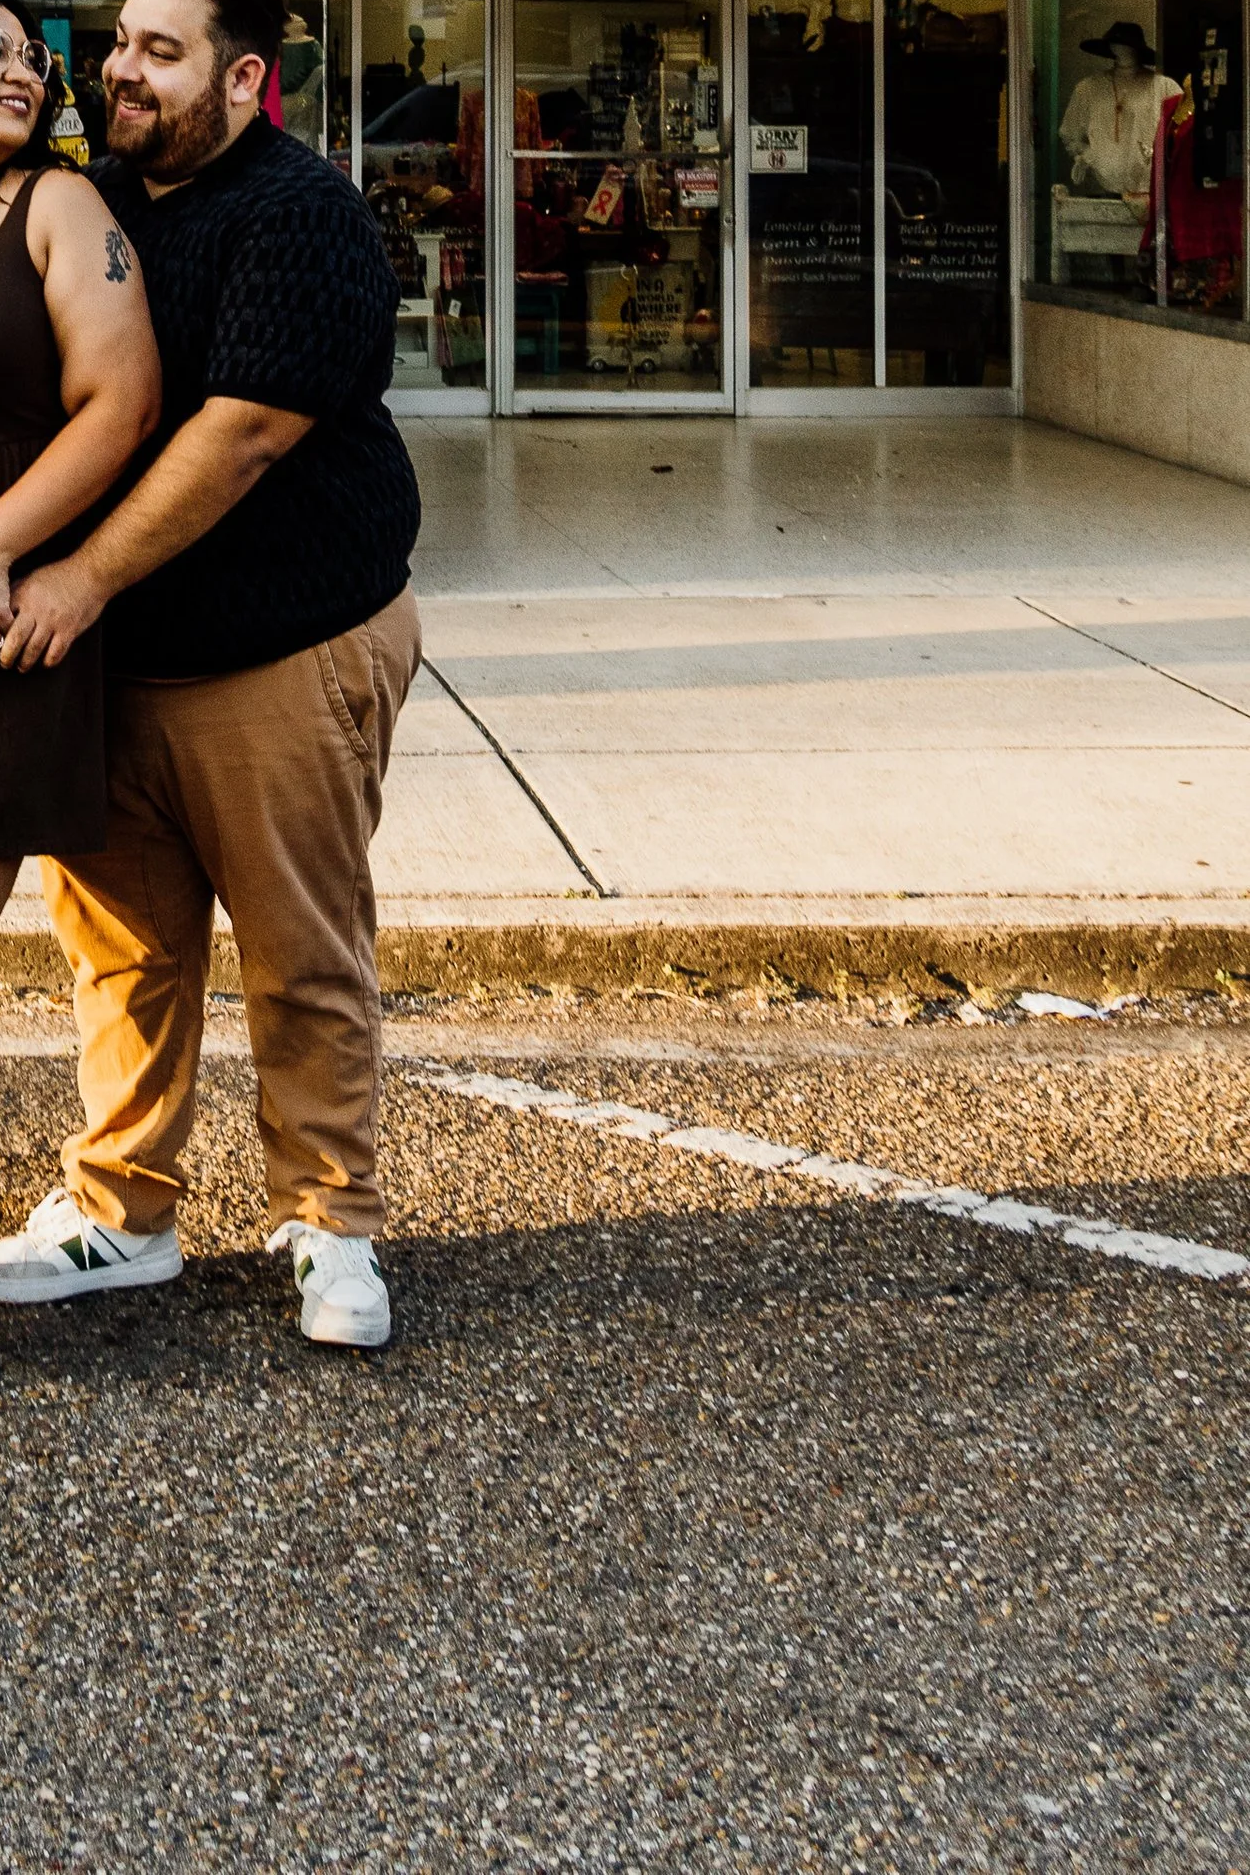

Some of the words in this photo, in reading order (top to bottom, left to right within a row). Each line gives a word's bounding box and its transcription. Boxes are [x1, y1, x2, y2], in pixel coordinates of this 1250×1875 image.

[709, 87, 718, 125] PULL
[757, 129, 798, 141] SORRY
[637, 303, 681, 313] WHERE
